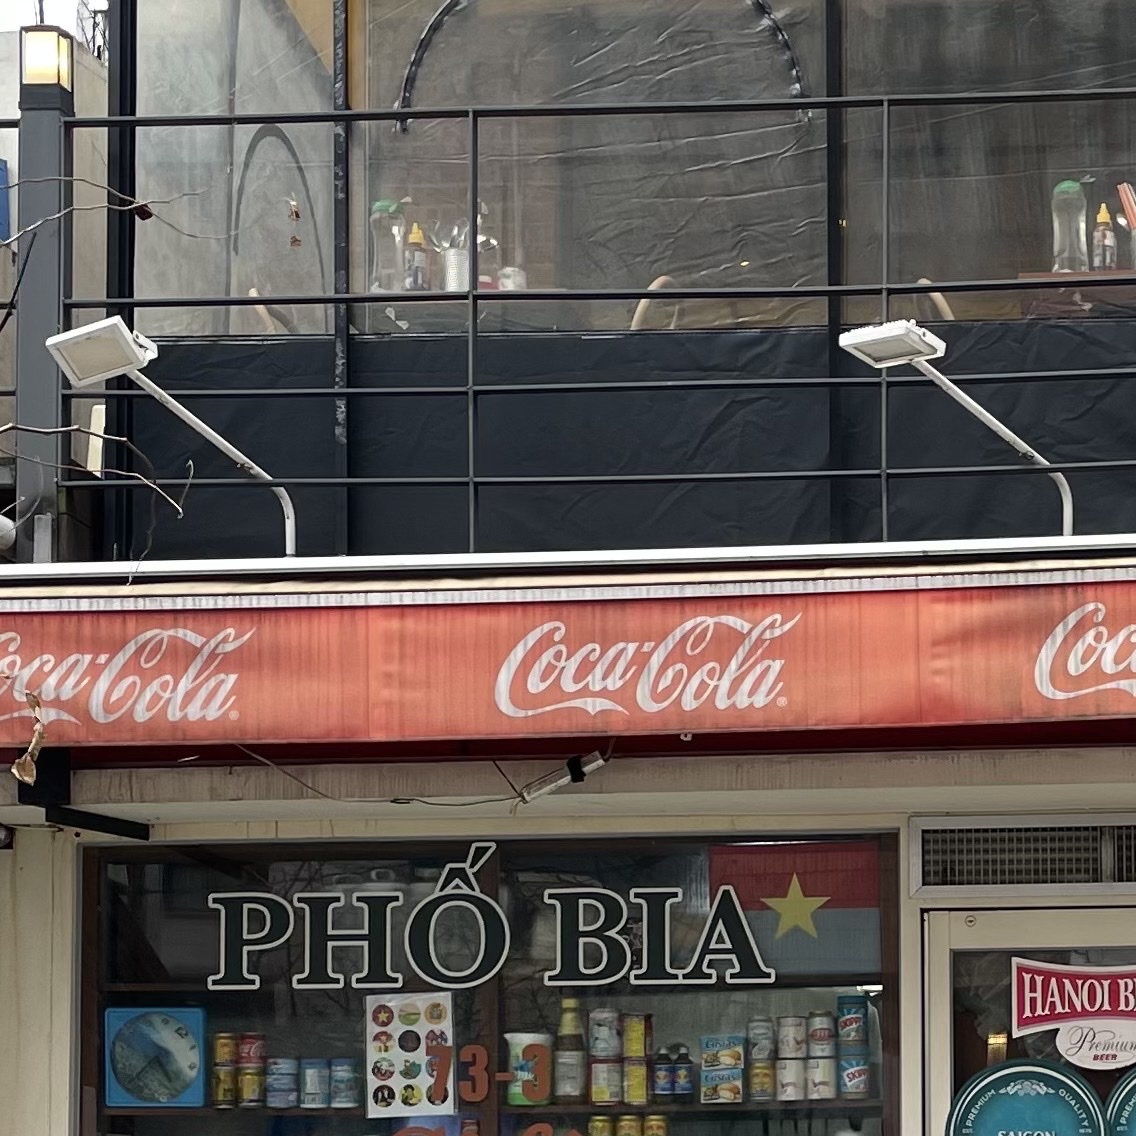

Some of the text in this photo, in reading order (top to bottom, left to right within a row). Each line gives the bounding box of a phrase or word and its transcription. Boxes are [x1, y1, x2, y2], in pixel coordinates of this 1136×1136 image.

[495, 612, 802, 718] Coca-Cola
[543, 885, 776, 986] BIA
[1022, 972, 1111, 1018] HANOI
[425, 1044, 552, 1102] 73-3
[1092, 1053, 1118, 1062] BEER
[965, 1088, 1090, 1127] PREMIUM QUALITY
